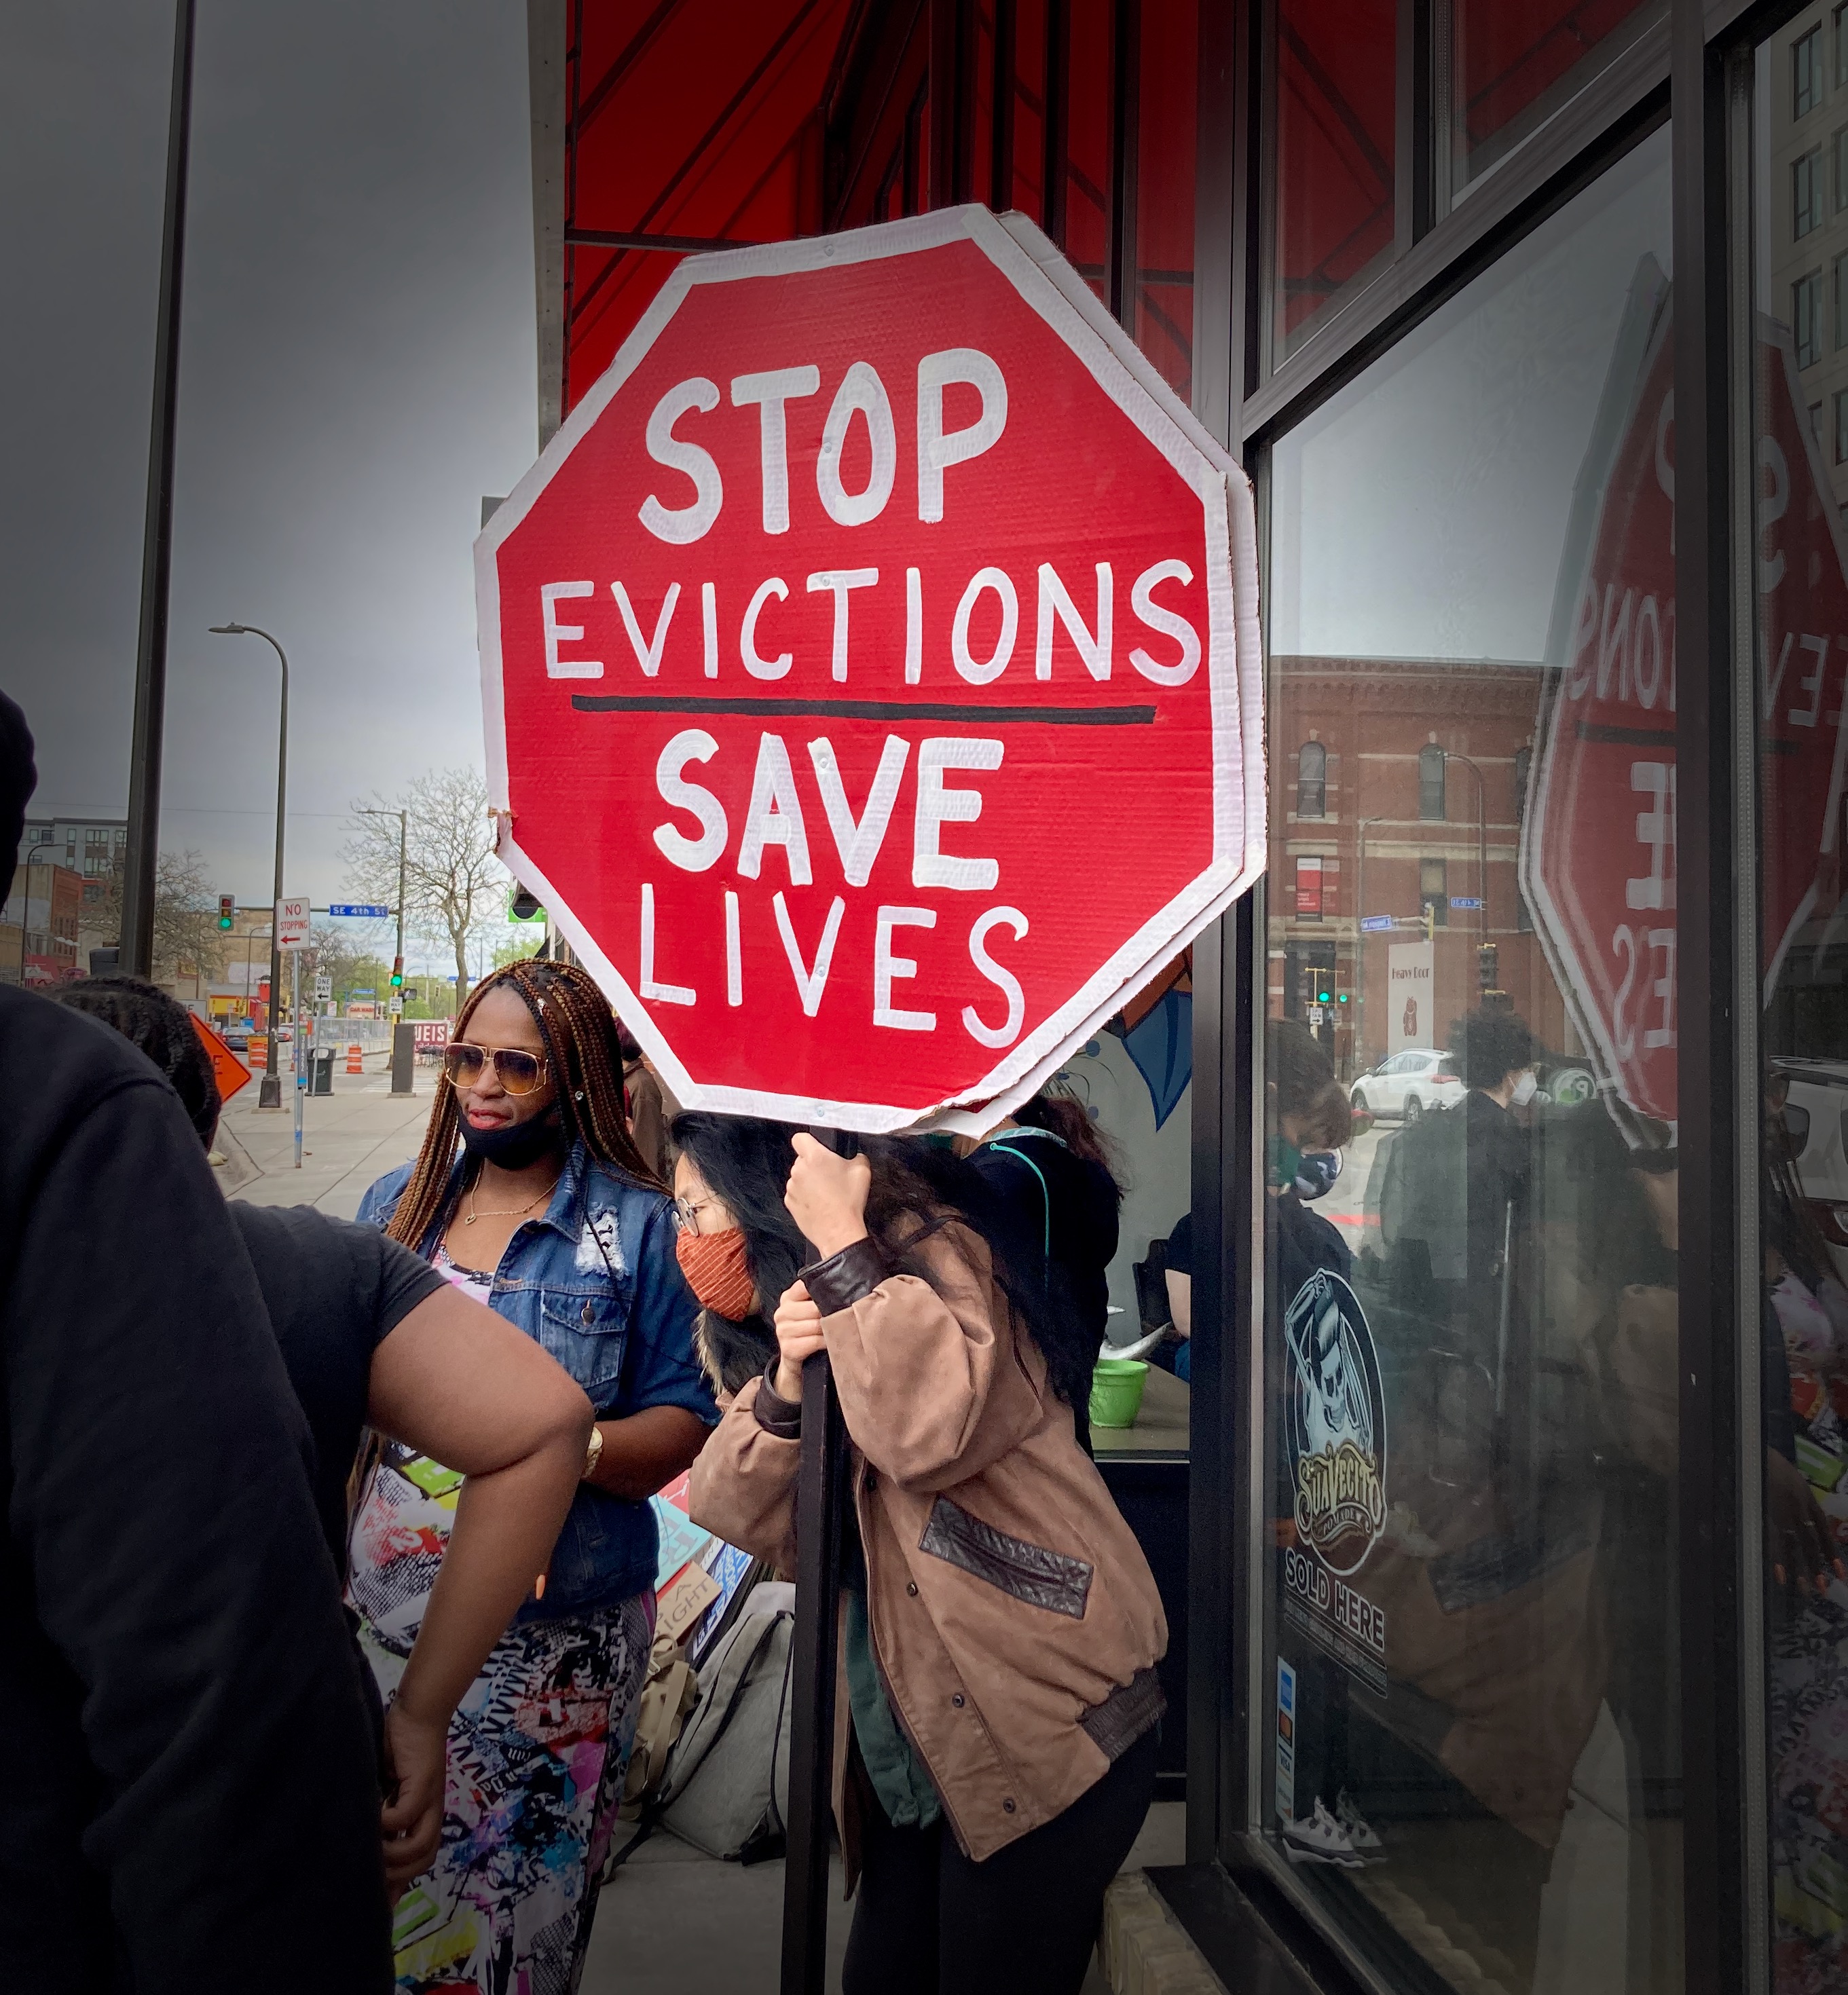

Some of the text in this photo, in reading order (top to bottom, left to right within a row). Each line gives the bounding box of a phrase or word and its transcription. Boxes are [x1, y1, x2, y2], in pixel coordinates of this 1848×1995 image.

[639, 348, 1008, 544] STOP
[541, 559, 1202, 686] EVICTIONS
[652, 728, 1005, 891] SAVE
[280, 920, 308, 931] STOPPING
[285, 903, 301, 916] NO
[333, 906, 386, 916] SE 4th St
[640, 883, 1029, 1049] LIVES
[1296, 1443, 1383, 1533] SUAVECITO
[1323, 1508, 1356, 1535] POMADE
[1285, 1546, 1331, 1610] SOLD
[1334, 1579, 1385, 1653] HERE
